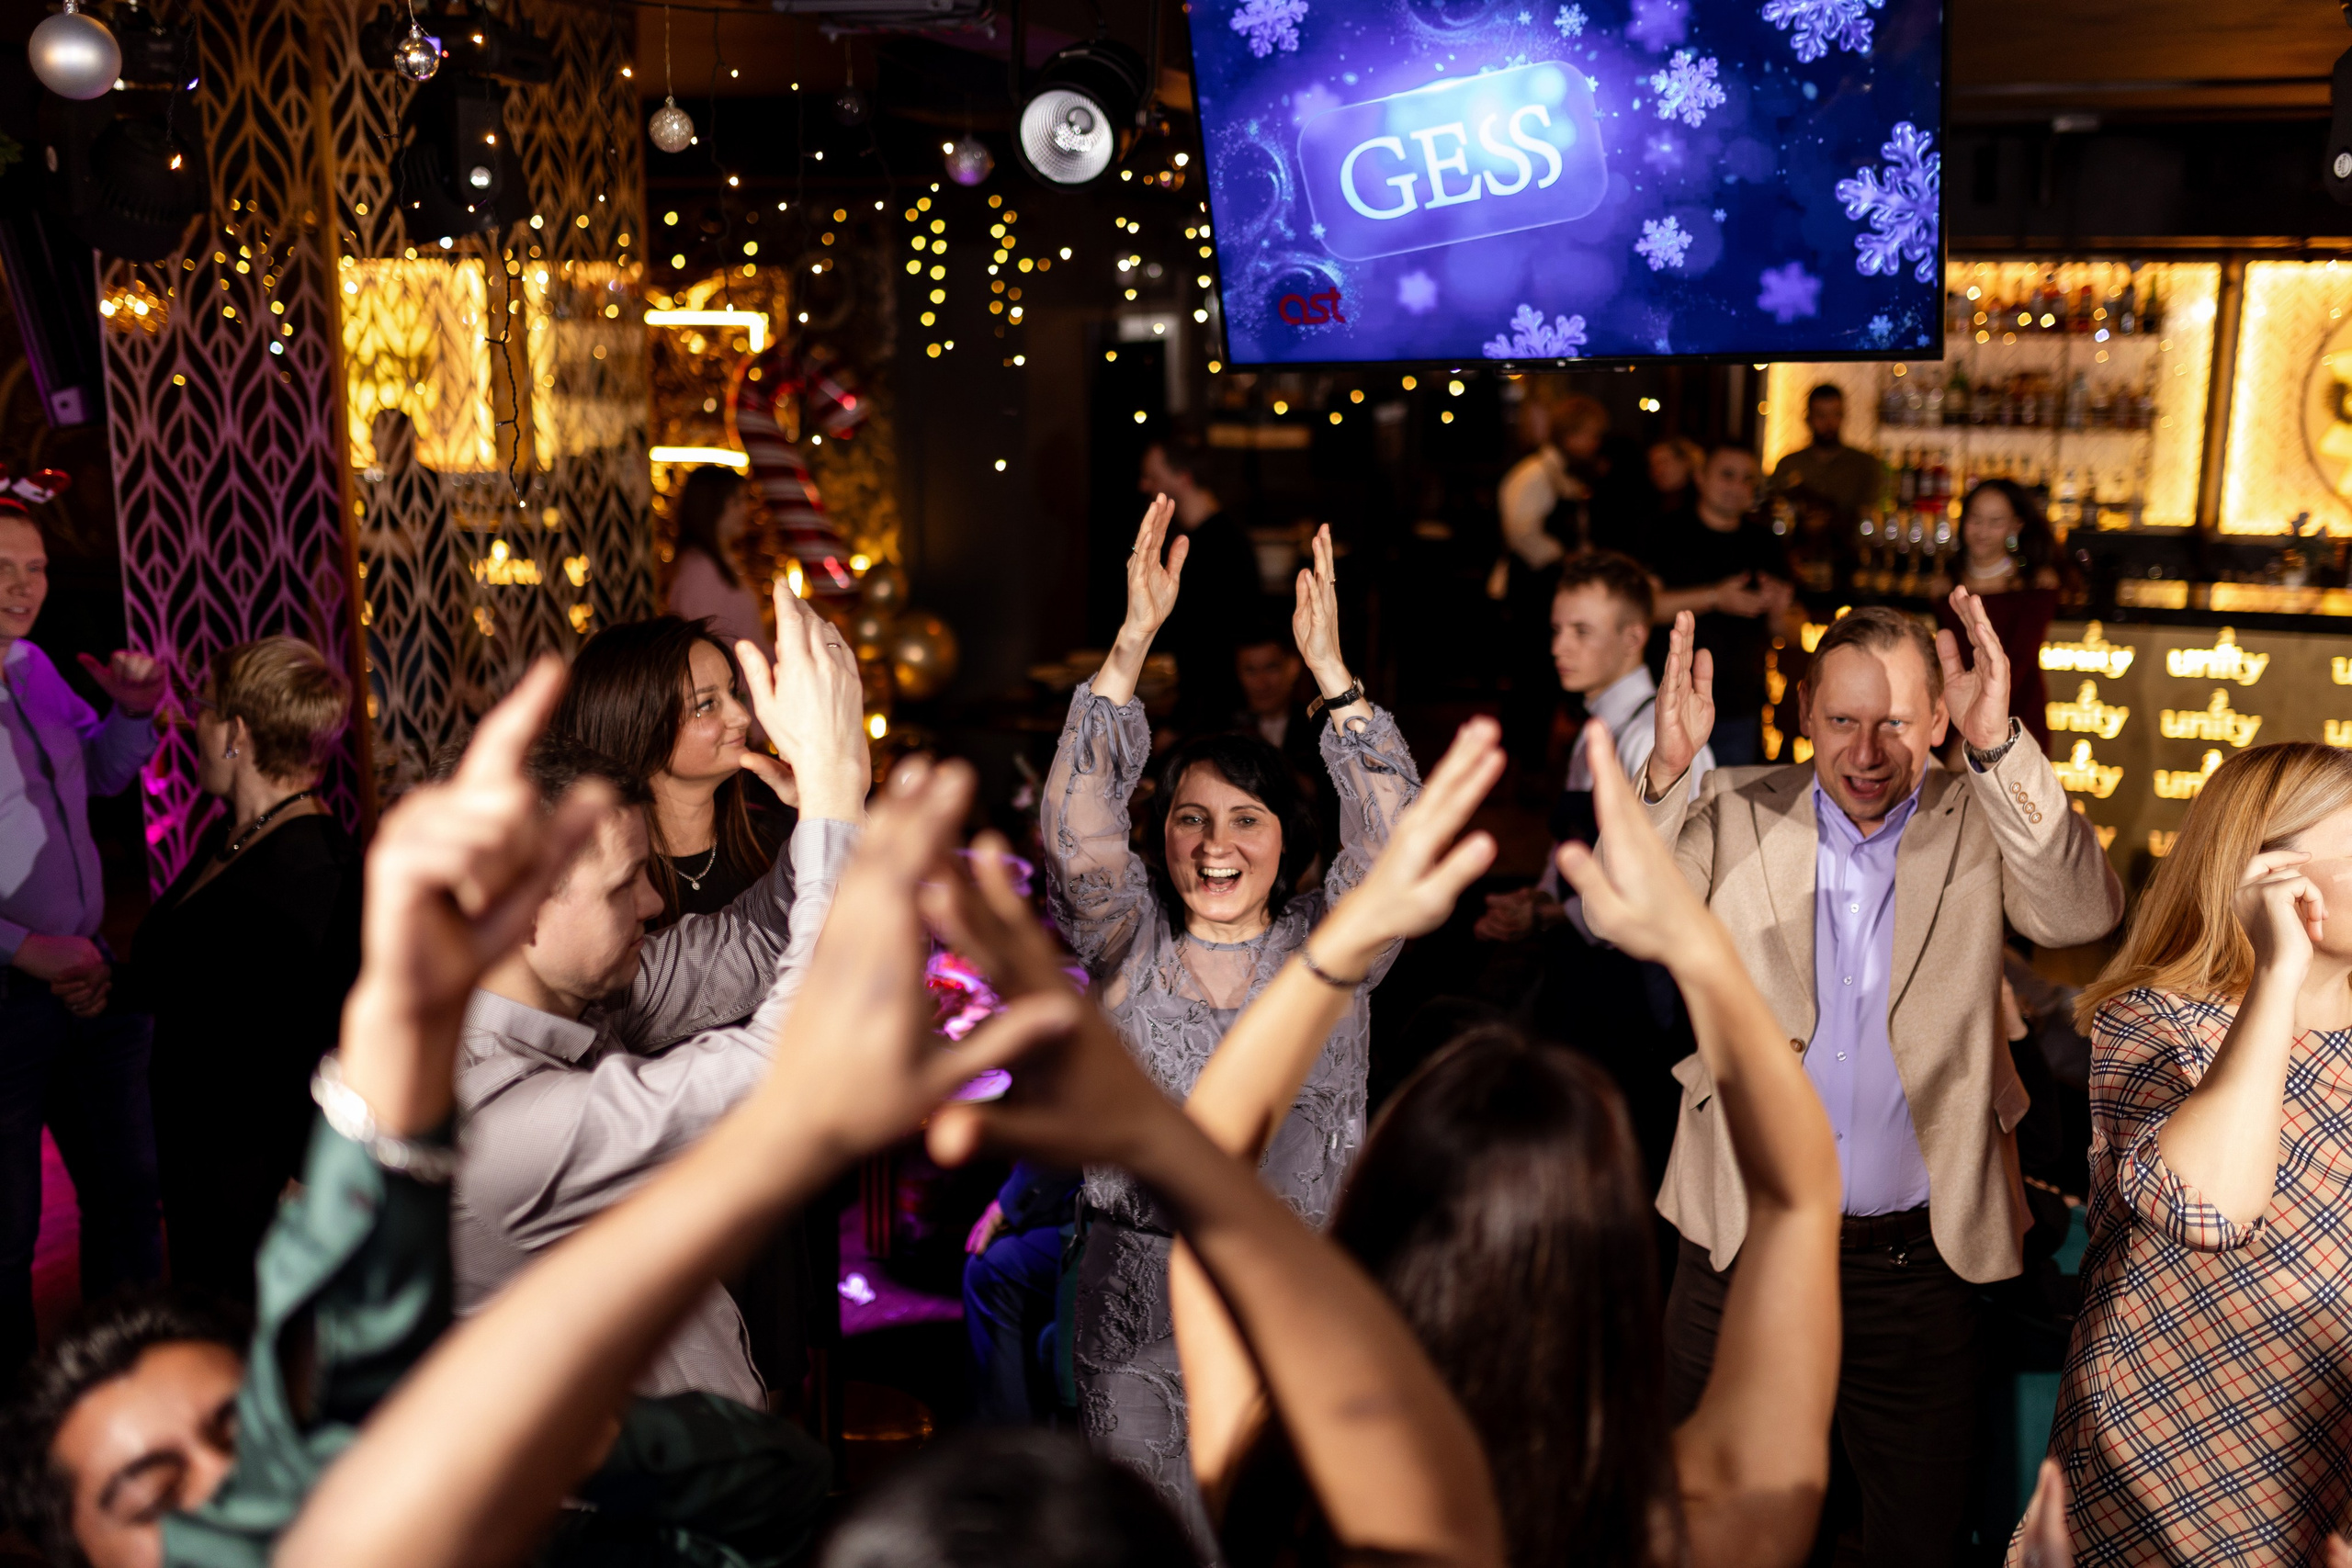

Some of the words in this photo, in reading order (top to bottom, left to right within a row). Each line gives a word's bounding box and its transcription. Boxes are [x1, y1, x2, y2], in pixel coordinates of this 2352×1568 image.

[1340, 104, 1563, 220] GESS
[2166, 626, 2270, 686] unity
[2160, 687, 2263, 748] unity
[2051, 739, 2124, 799] nity
